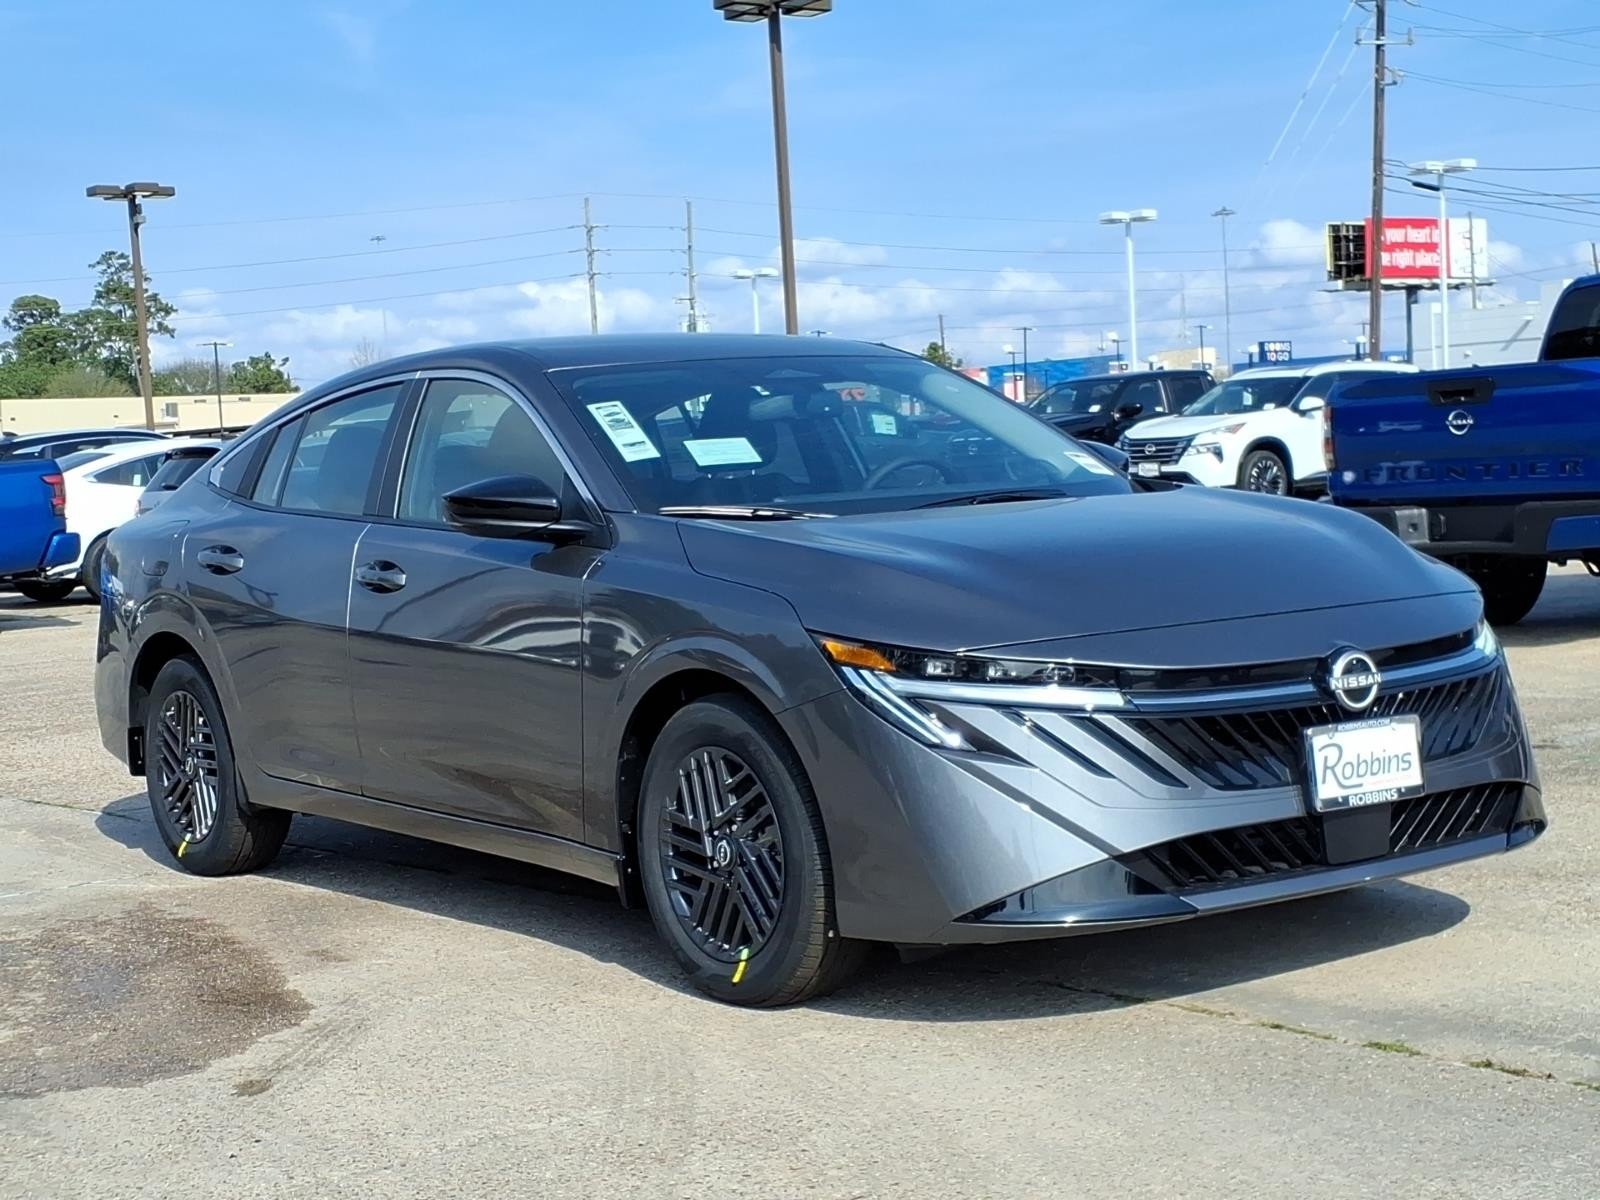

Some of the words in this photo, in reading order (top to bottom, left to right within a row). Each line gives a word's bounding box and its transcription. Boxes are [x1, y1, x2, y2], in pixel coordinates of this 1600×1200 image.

[1384, 227, 1405, 245] your
[1406, 225, 1430, 243] heart
[1391, 248, 1414, 268] right
[1264, 342, 1290, 351] ROOMS
[1266, 352, 1276, 361] TO
[1277, 352, 1289, 361] GO
[1363, 459, 1585, 484] FRONTIER
[1329, 673, 1381, 691] NISSAN
[1318, 743, 1412, 789] Robbins
[1349, 788, 1398, 806] ROBBINS
